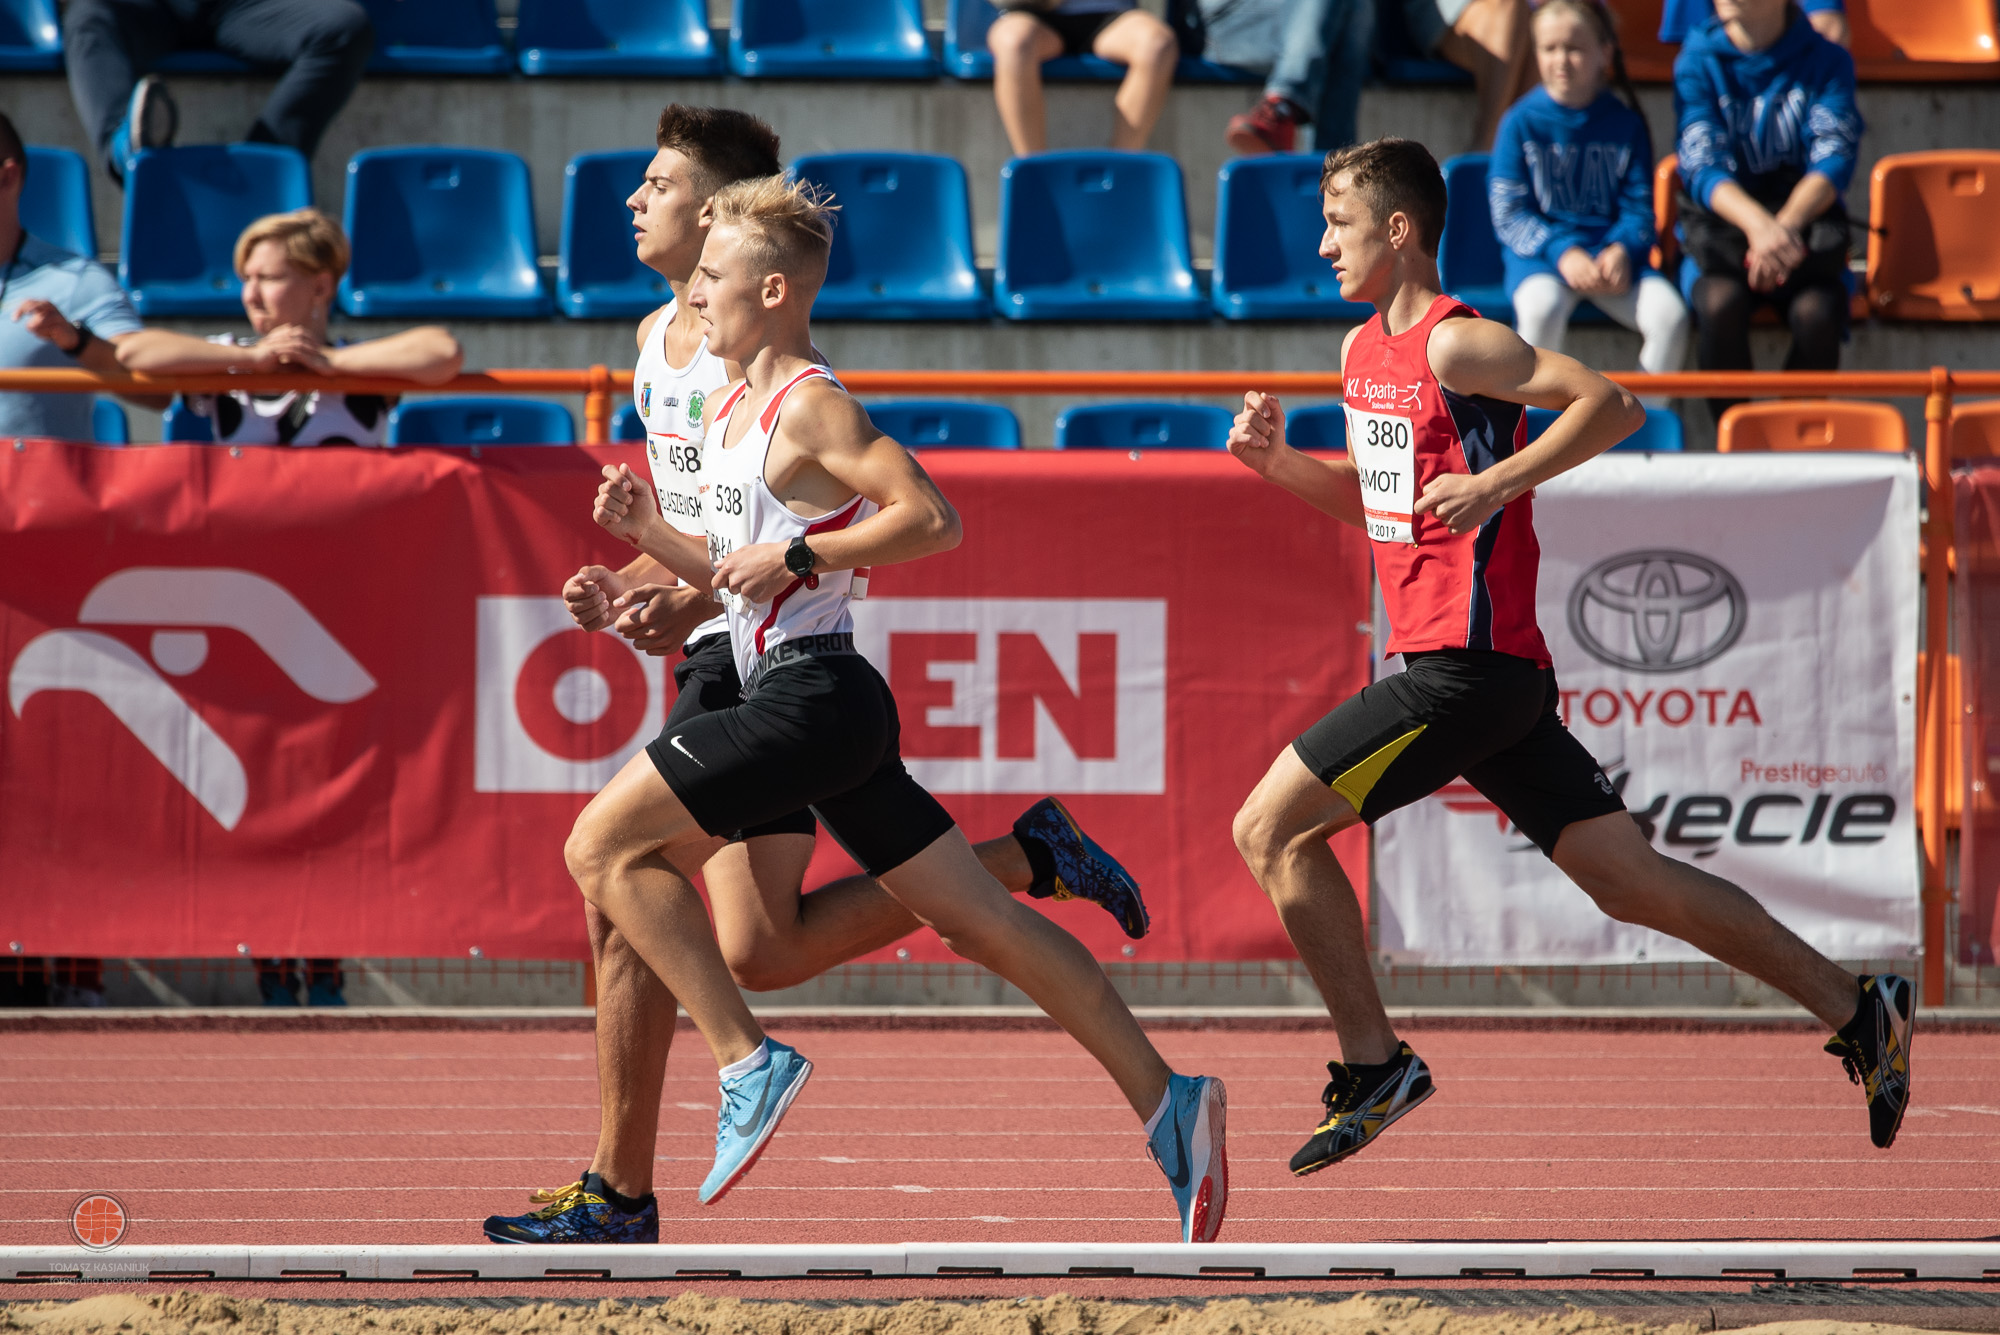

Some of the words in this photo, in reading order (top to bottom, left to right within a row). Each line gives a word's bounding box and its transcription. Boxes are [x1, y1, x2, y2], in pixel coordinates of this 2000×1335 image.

[1346, 377, 1359, 398] KL
[1362, 378, 1397, 403] Sparta
[1367, 418, 1409, 450] 380
[669, 444, 702, 473] 458
[1357, 466, 1401, 494] AMOT
[716, 484, 743, 516] 538
[1375, 524, 1397, 539] 2019
[757, 640, 795, 677] NIKE
[799, 632, 843, 656] PRO
[515, 628, 1118, 763] OEN
[1558, 688, 1763, 728] TOYOTA
[1740, 759, 1889, 788] Prestigeauto
